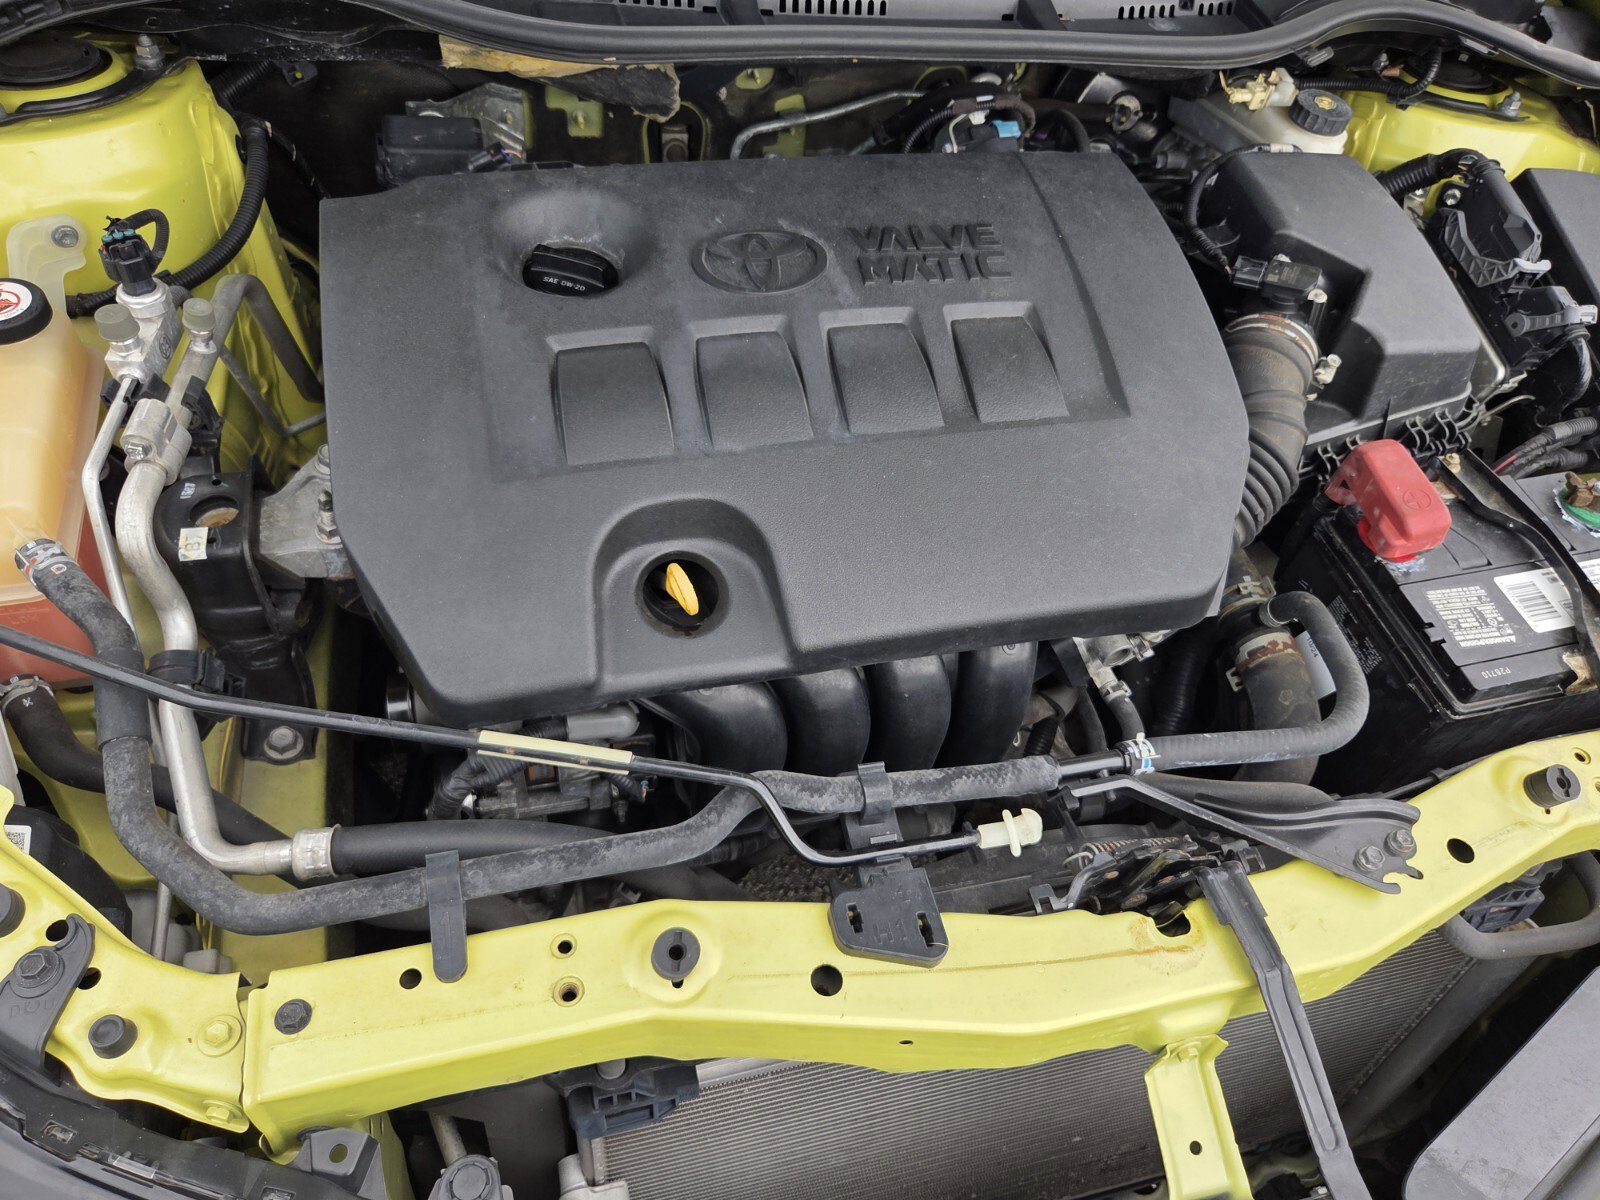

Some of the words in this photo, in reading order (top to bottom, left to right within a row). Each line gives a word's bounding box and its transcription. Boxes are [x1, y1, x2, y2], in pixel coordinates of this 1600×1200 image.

[846, 223, 1000, 251] VALVE
[857, 252, 1012, 285] MATIC
[543, 276, 560, 285] SAE
[561, 280, 586, 292] 0W-20
